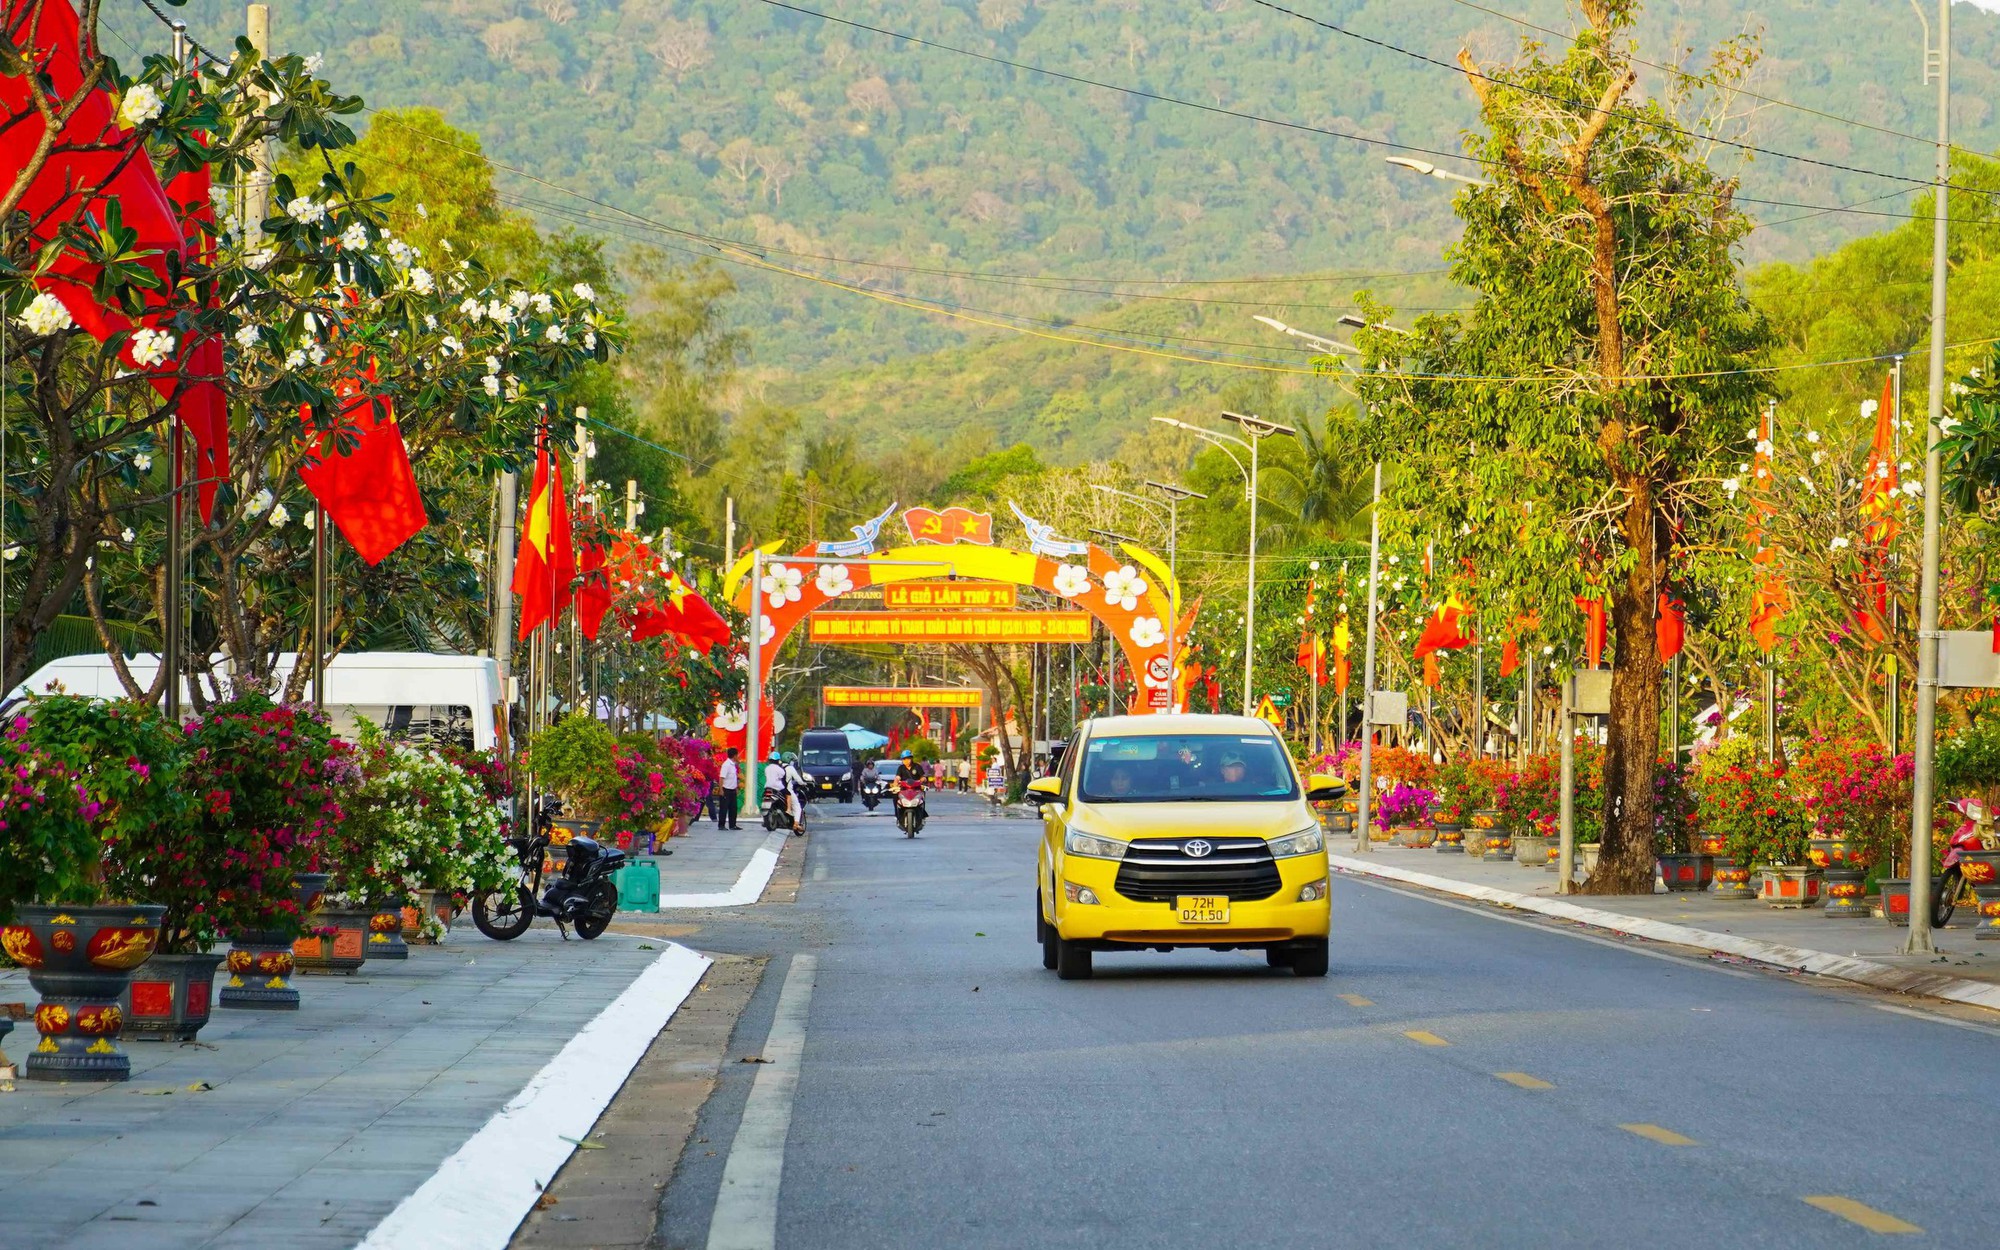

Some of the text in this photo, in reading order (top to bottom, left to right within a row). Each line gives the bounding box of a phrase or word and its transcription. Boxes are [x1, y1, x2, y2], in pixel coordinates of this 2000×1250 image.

[852, 591, 882, 599] TRANG
[993, 590, 1010, 604] 74
[1192, 898, 1214, 908] 72H
[1183, 910, 1223, 921] 021.50
